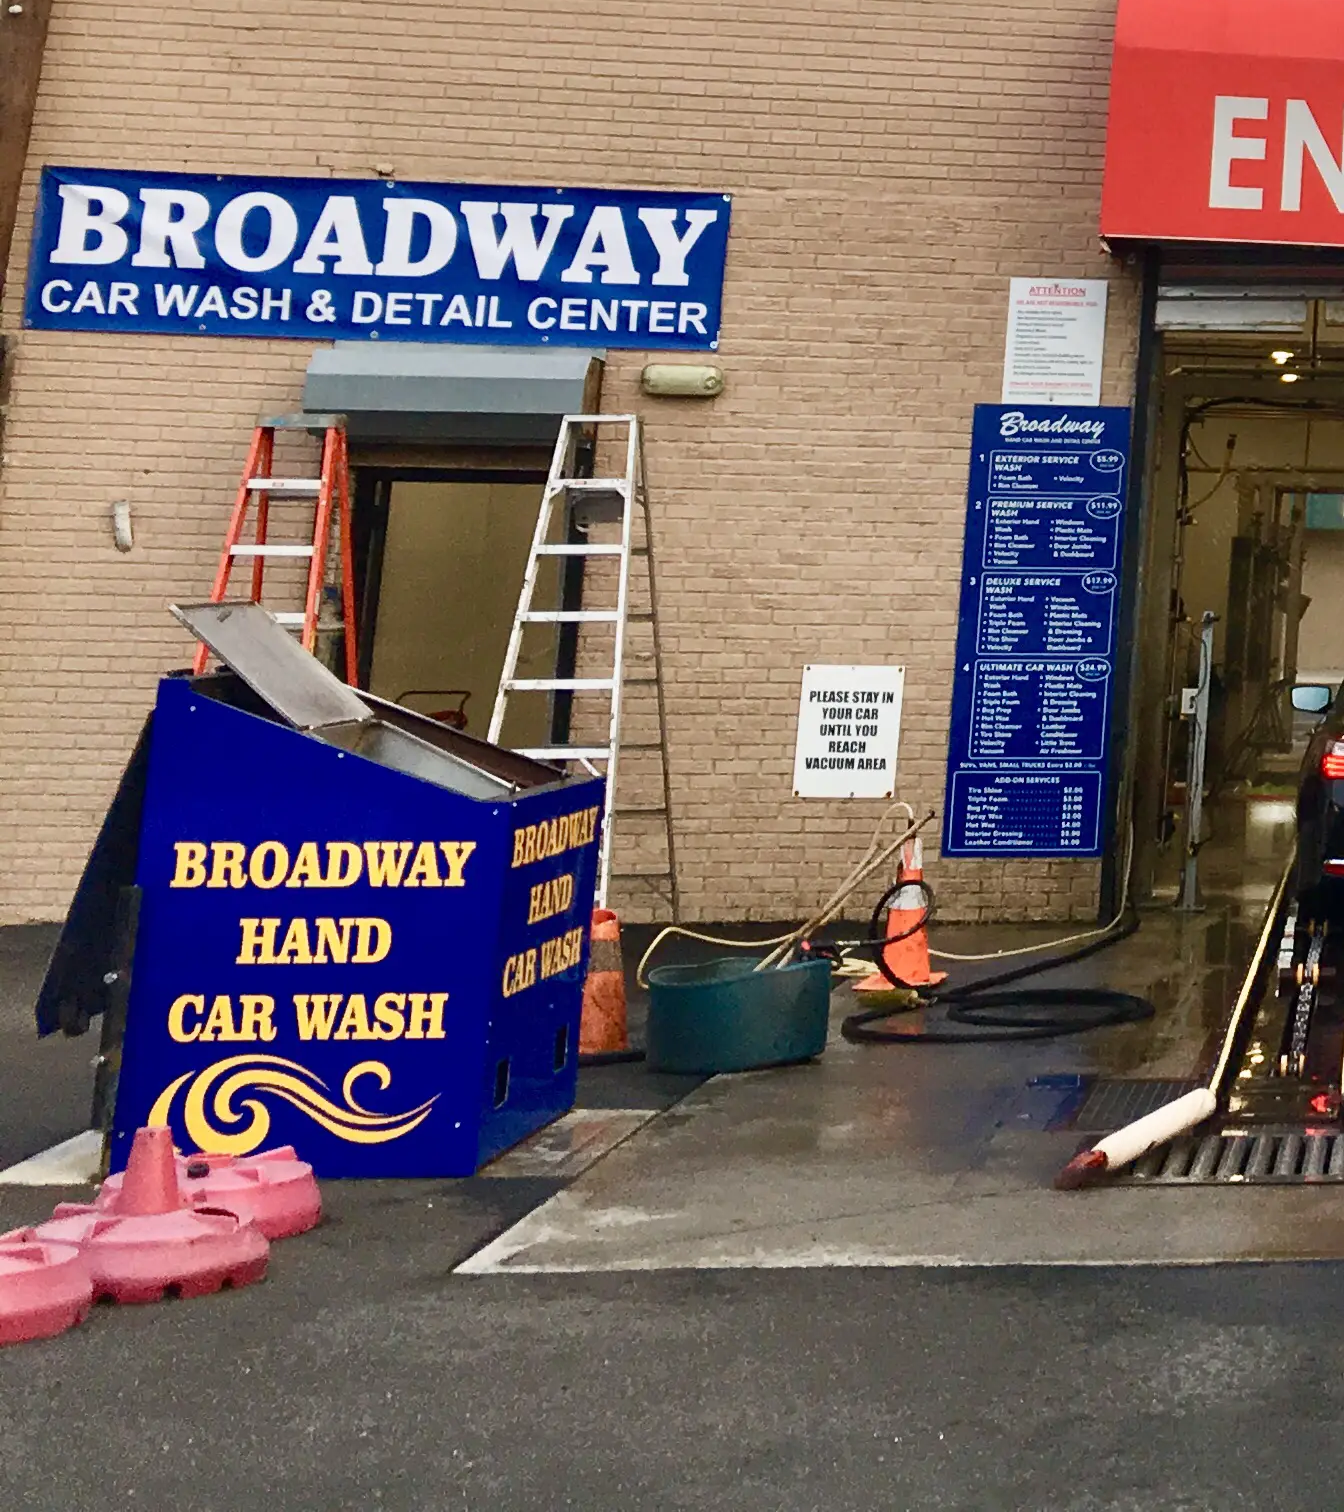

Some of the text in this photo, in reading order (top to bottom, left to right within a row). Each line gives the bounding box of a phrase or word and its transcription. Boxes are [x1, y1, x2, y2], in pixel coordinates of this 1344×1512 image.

[50, 185, 717, 286] BROADWAY
[41, 280, 708, 333] CAR WASH & DETAIL CENTER
[1029, 286, 1086, 296] ATTENTION
[1000, 411, 1105, 439] Broadway
[995, 455, 1040, 463] EXTERIOR
[810, 691, 894, 703] PLEASE STAY IN
[822, 708, 878, 720] YOUR CAR
[820, 724, 878, 736] UNTIL YOU
[828, 741, 866, 753] REACH
[806, 758, 886, 770] VACUUM AREA
[511, 806, 600, 869] BROADWAY
[170, 841, 476, 889] BROADWAY
[527, 873, 573, 925] HAND
[235, 917, 392, 964] HAND
[502, 926, 584, 998] CAR WASH
[167, 992, 449, 1043] CAR WASH
